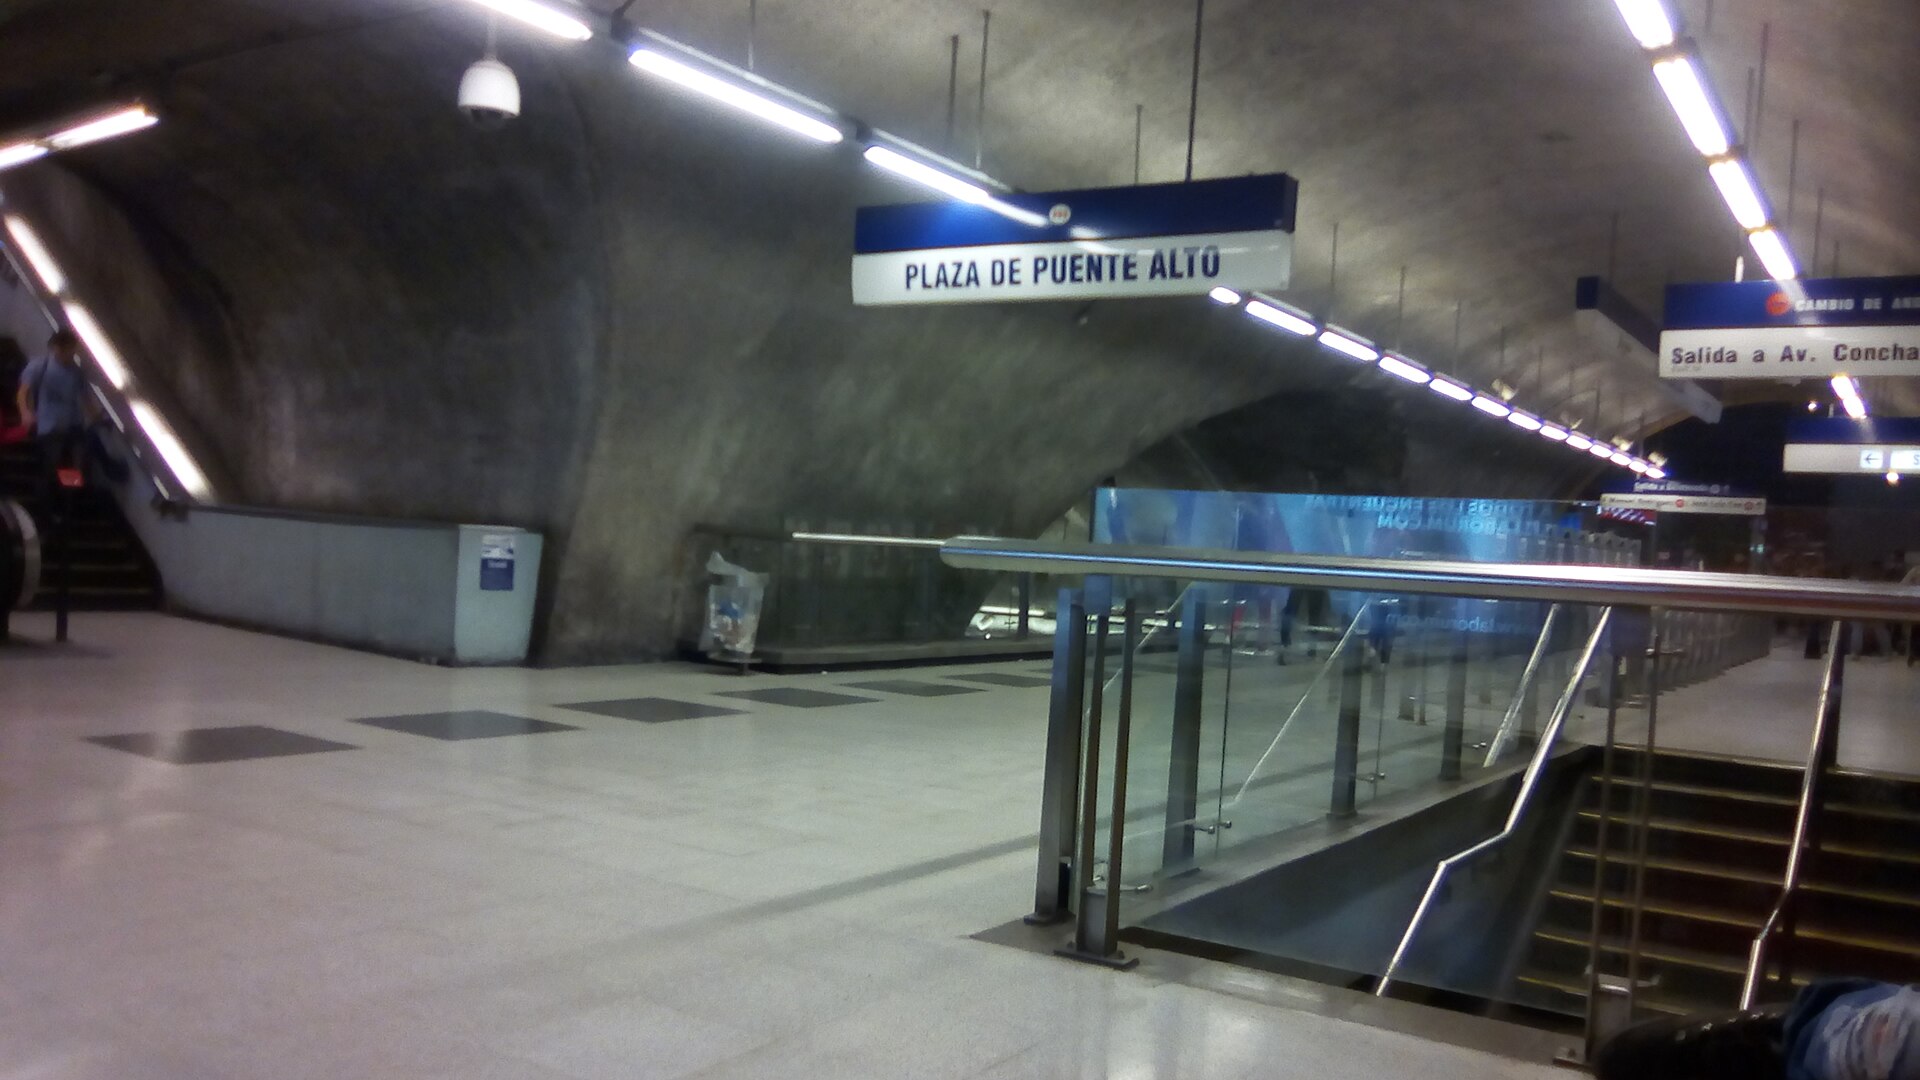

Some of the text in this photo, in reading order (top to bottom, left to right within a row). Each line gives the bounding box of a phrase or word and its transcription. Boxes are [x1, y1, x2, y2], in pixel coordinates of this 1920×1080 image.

[905, 245, 1221, 291] PLAZA DE PUENTE ALTO
[1795, 298, 1855, 312] CAMBIO
[1863, 298, 1882, 310] DE
[1671, 342, 1920, 365] Salida a Av. Concha
